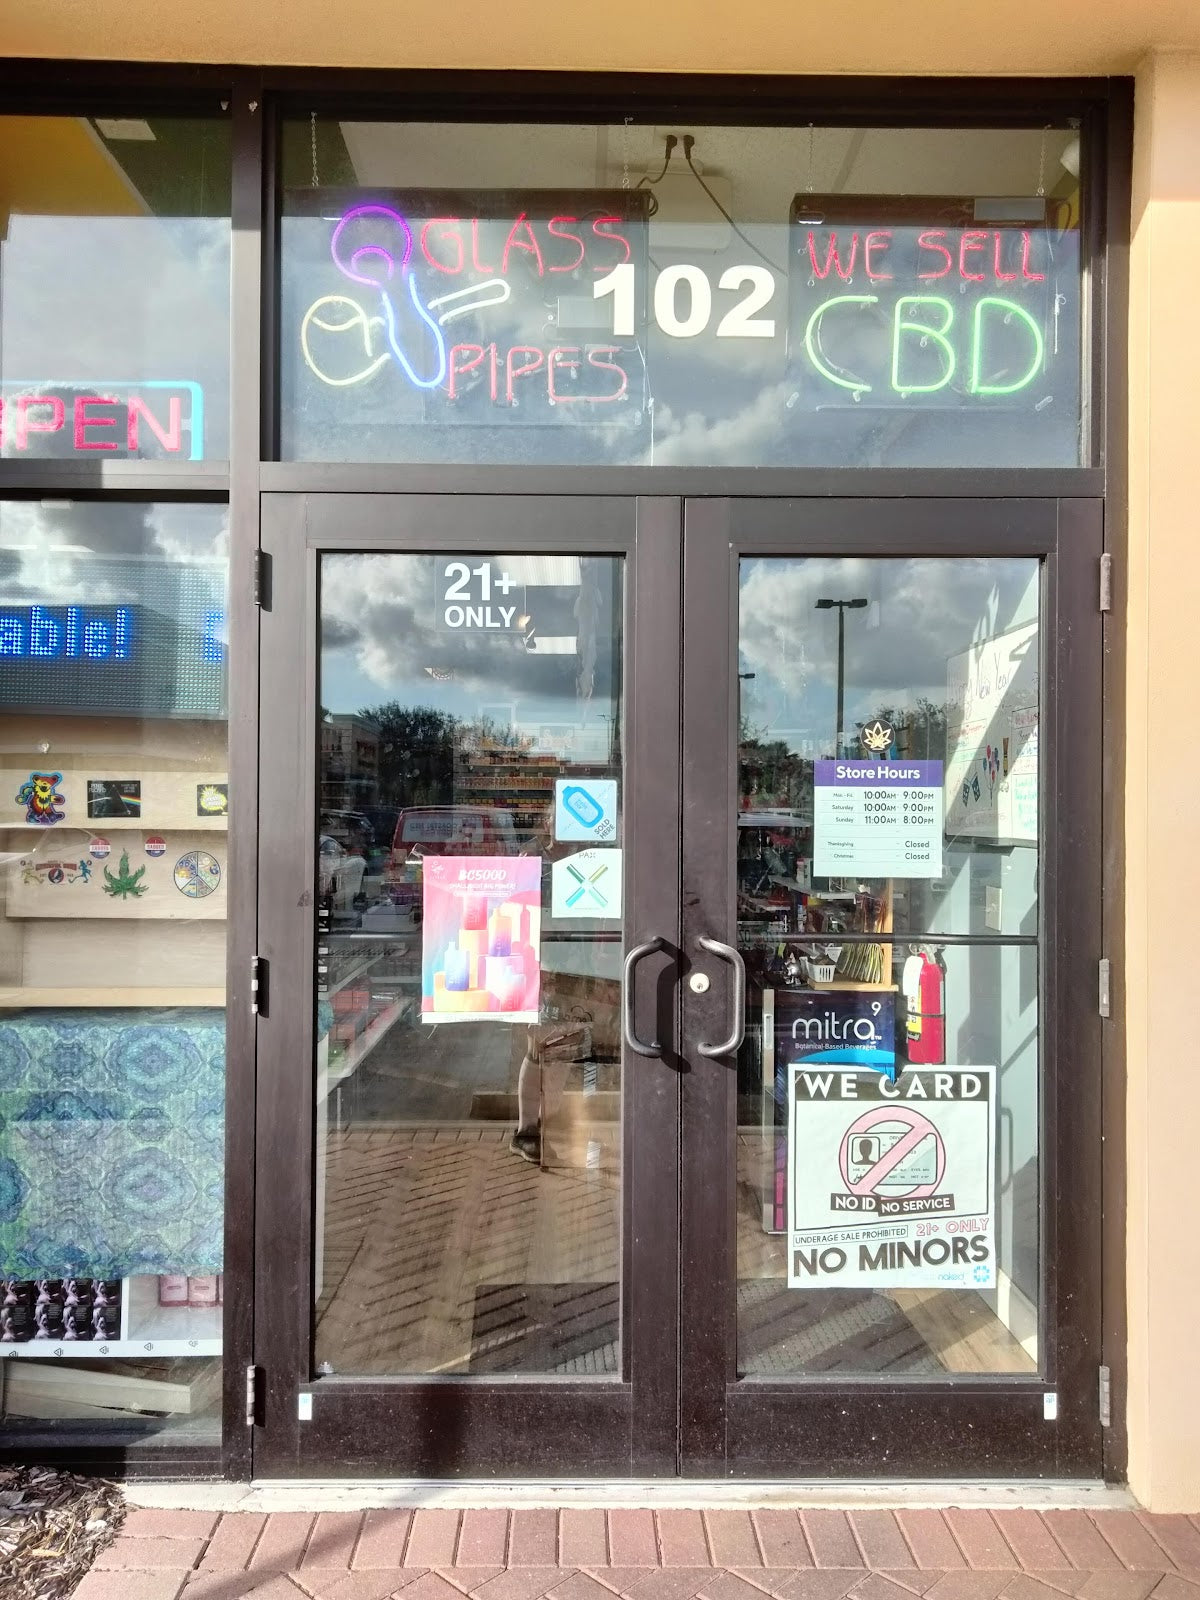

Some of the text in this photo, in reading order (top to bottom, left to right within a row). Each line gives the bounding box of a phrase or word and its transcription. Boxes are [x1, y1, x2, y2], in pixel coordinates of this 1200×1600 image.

[421, 213, 631, 276] GLASS
[807, 231, 1044, 281] WE SELL
[593, 263, 776, 338] 102
[805, 295, 1044, 393] CBD
[447, 344, 629, 402] PIPES
[0, 396, 182, 452] PEN
[444, 562, 517, 600] 21+
[444, 605, 517, 628] ONLY
[0, 605, 125, 658] able!
[836, 766, 921, 779] Store Hours
[594, 818, 610, 835] SOLD
[599, 823, 616, 839] HERE
[904, 840, 930, 848] Closed
[904, 852, 930, 860] Closed
[457, 869, 507, 881] BC5000
[795, 1042, 877, 1051] Botanical-Based Beverages
[804, 1073, 982, 1098] WE CARD
[835, 1197, 876, 1210] NO ID
[881, 1198, 951, 1213] NO SERVICE
[945, 1218, 990, 1234] ONLY
[795, 1228, 907, 1245] UNDERAGE SALE PROHIBITED
[793, 1235, 990, 1277] NO MINORS
